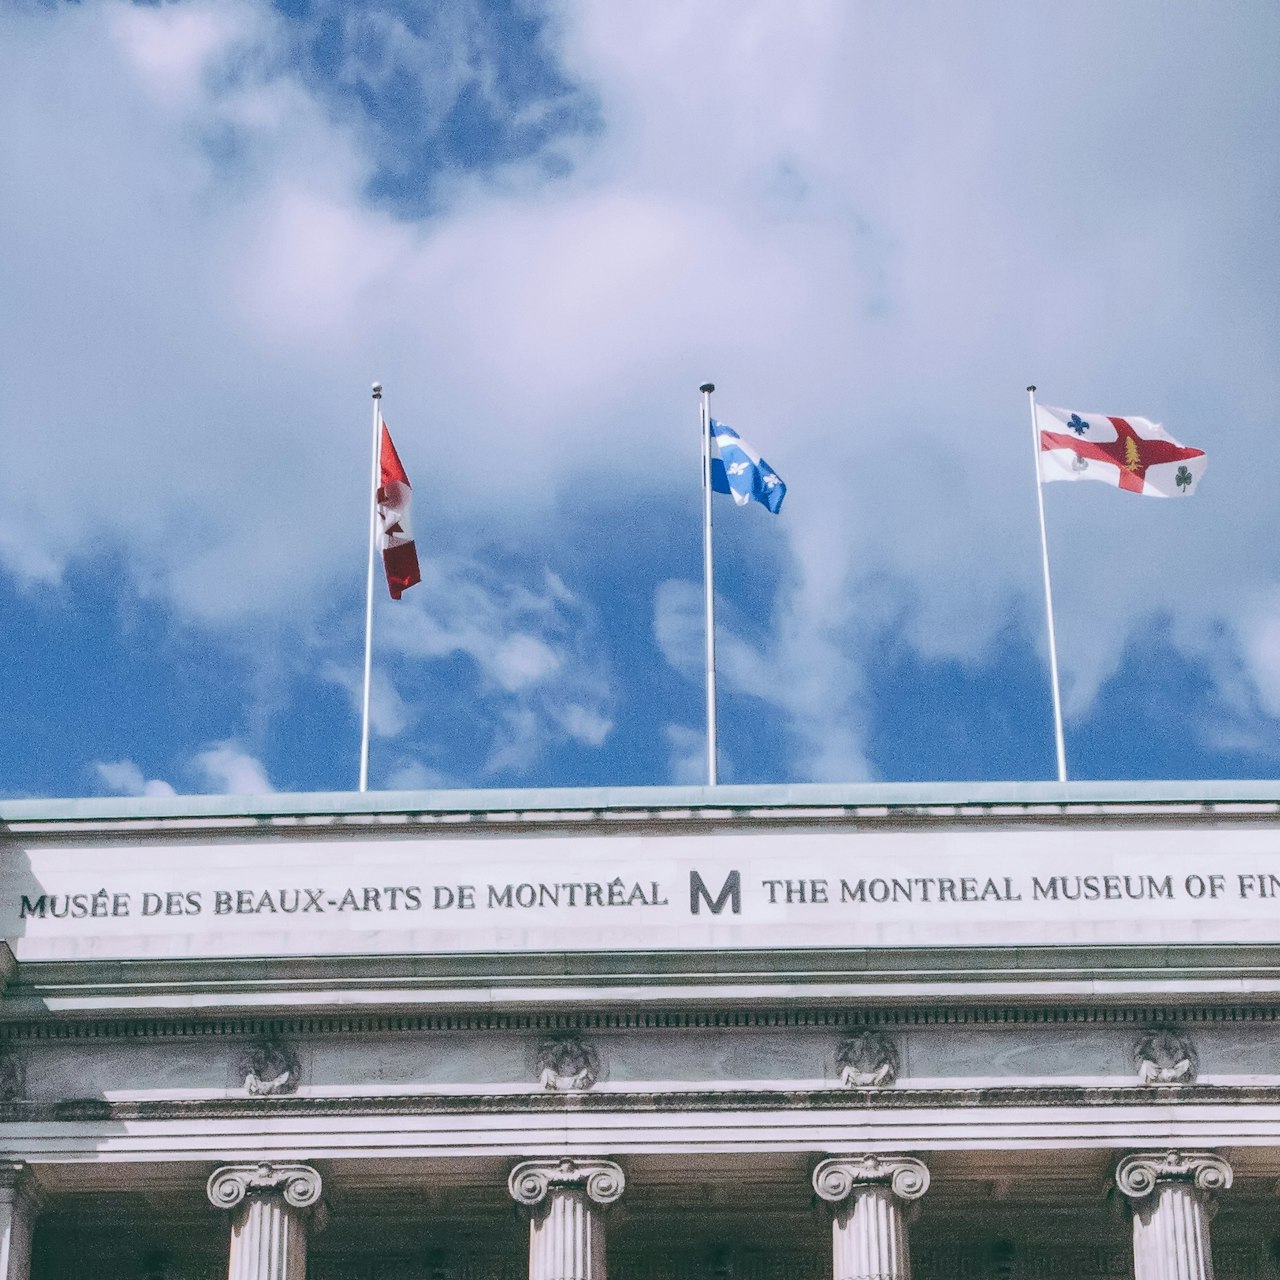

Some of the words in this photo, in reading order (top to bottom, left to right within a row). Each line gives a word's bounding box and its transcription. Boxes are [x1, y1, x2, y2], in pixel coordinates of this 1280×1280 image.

[18, 888, 130, 918] MUSÉE
[141, 891, 201, 917] DES
[214, 886, 422, 915] BEAUX-ARTS
[432, 885, 476, 909] DE
[487, 876, 669, 909] MONTRÉAL
[689, 869, 741, 915] M
[762, 879, 829, 903] THE
[840, 877, 1022, 902] MONTREAL
[1031, 875, 1175, 901] MUSEUM
[1184, 874, 1226, 899] OF
